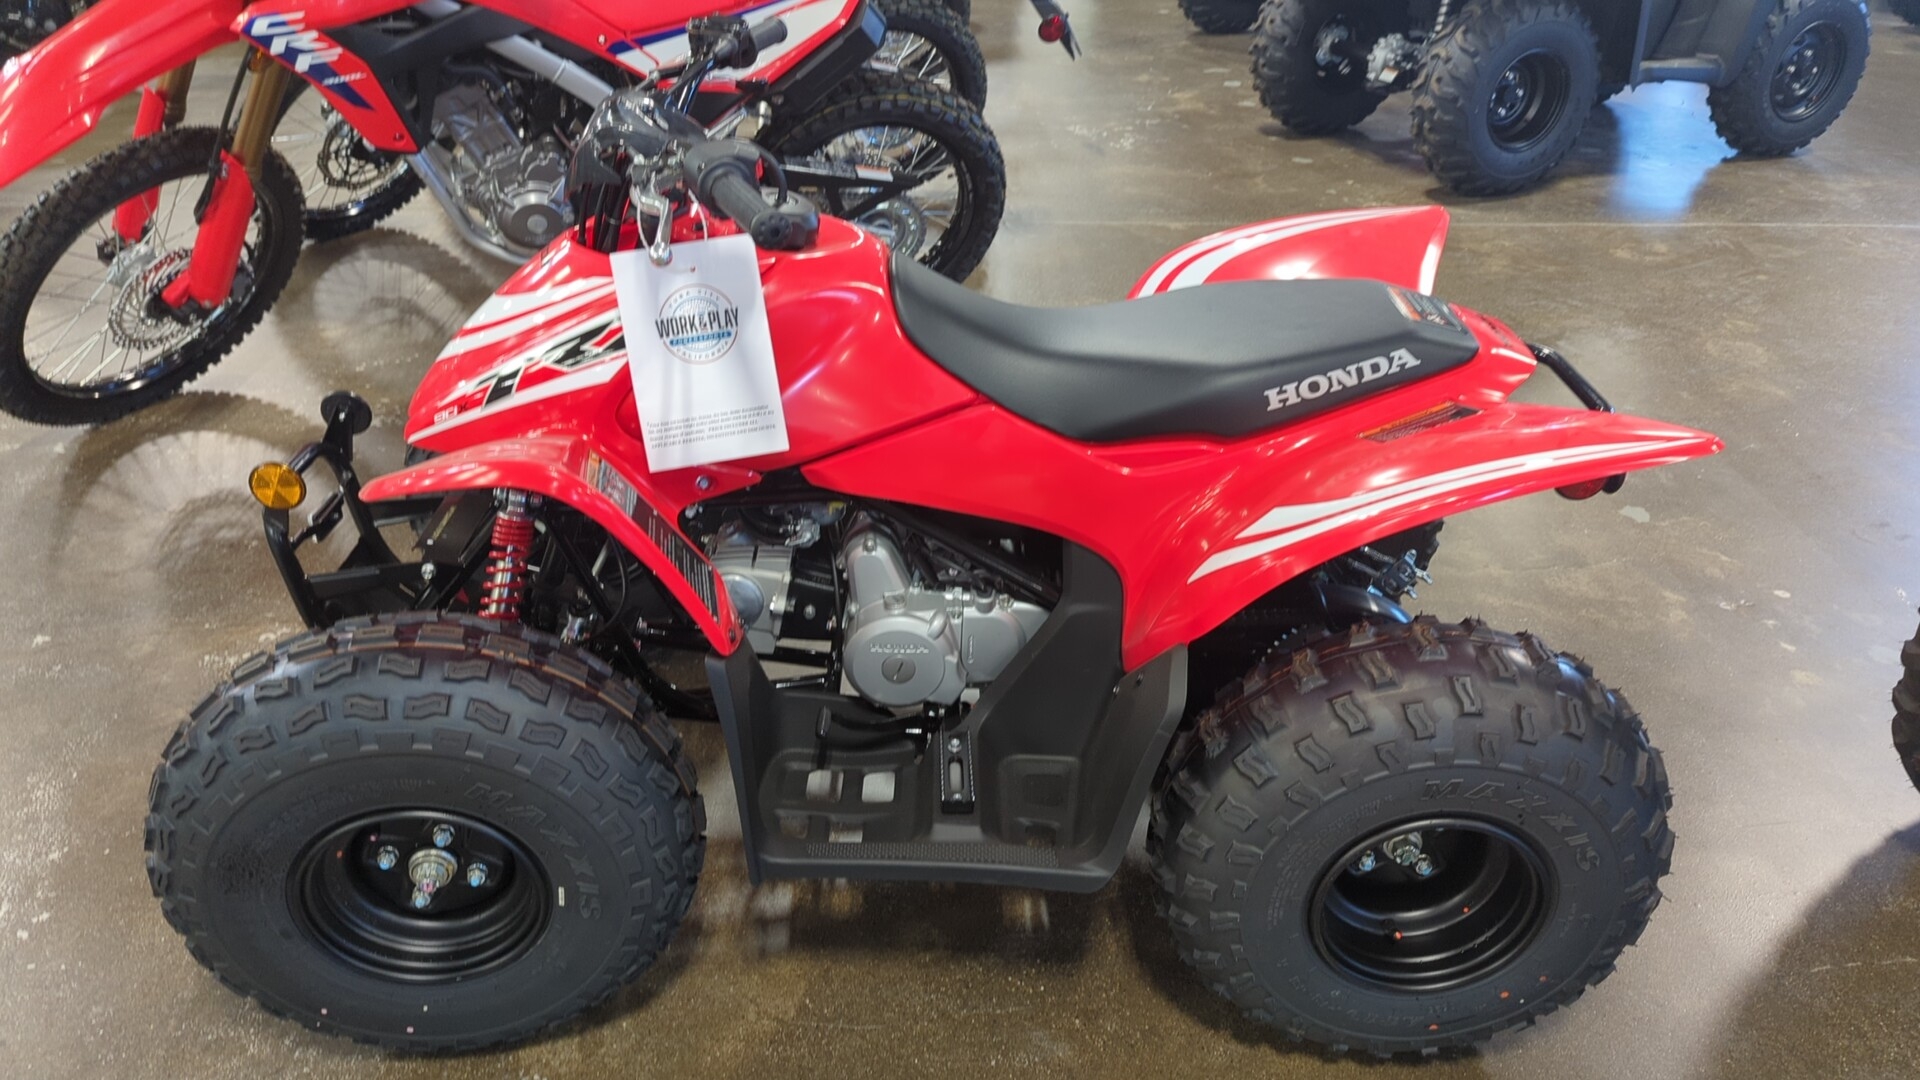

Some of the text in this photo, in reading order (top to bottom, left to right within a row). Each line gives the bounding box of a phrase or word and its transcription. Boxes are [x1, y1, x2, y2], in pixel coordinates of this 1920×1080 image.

[655, 313, 699, 340] WORK
[707, 306, 739, 332] PLAY
[1263, 347, 1422, 412] HONDA
[464, 782, 602, 920] MAXXIS
[1421, 779, 1600, 872] MAXXIS
